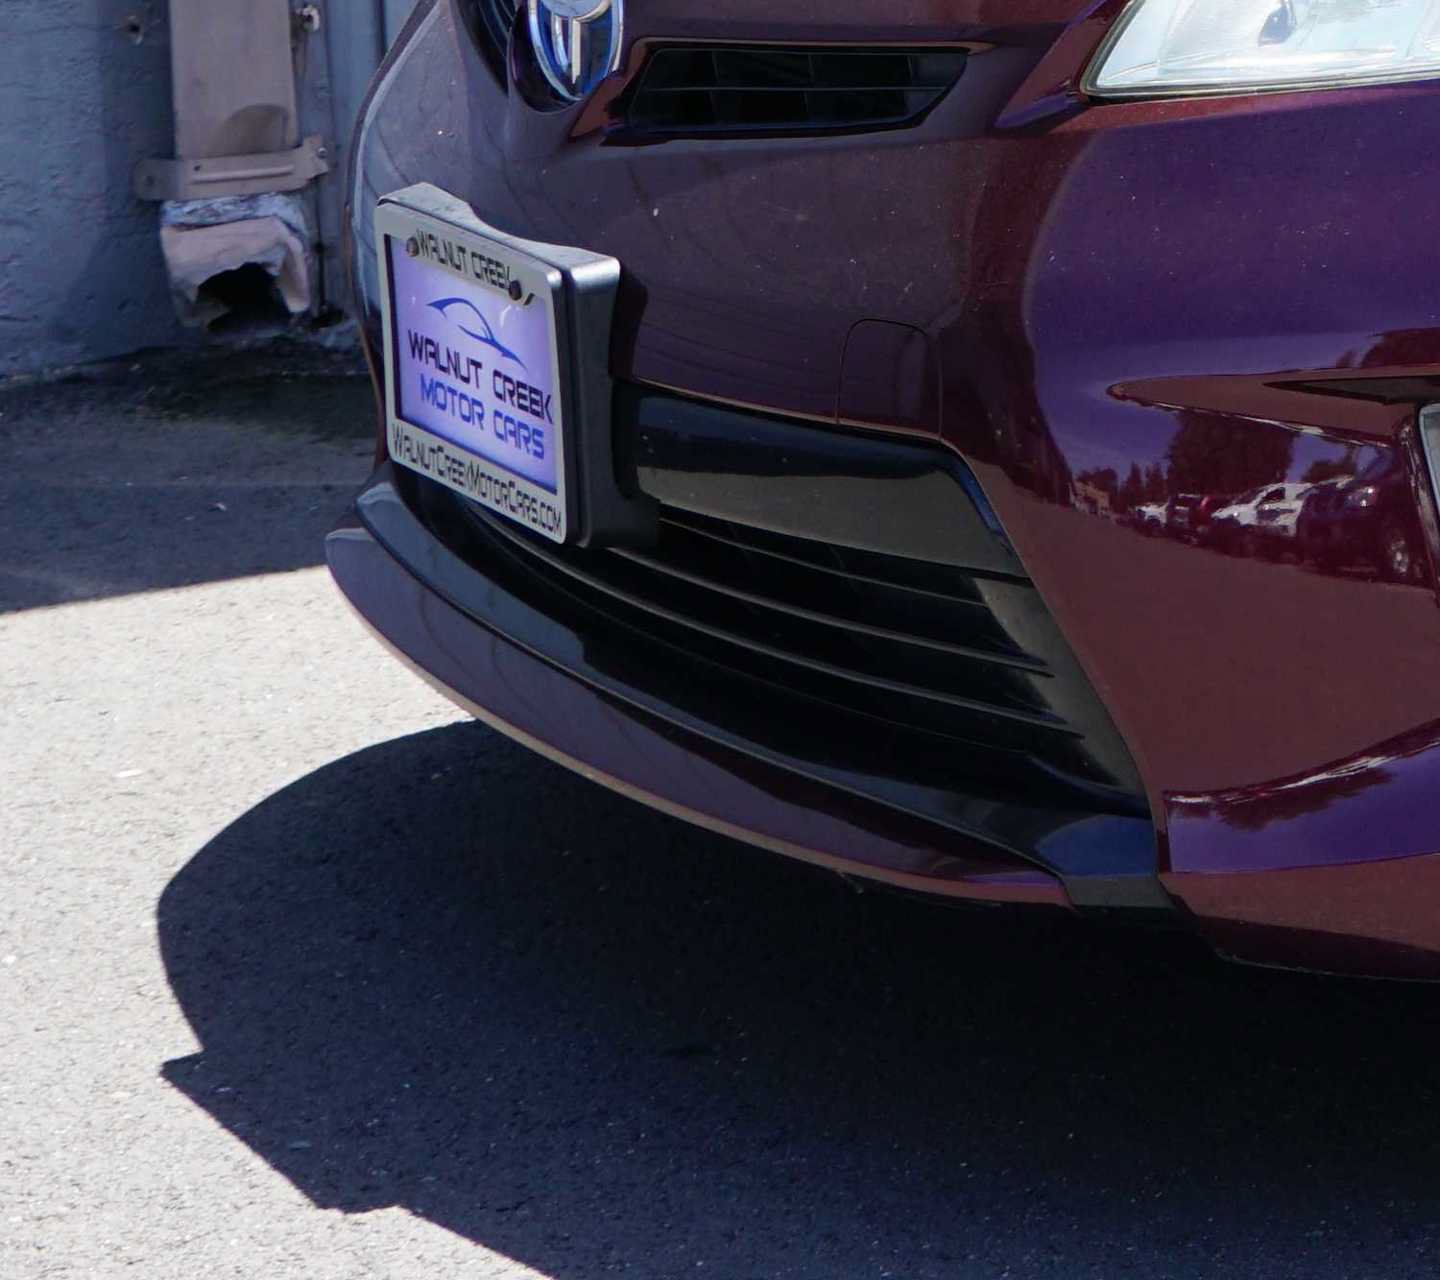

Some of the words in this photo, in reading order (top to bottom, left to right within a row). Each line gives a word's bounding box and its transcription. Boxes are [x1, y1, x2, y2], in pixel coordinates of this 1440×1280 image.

[417, 228, 467, 271] WALNUT
[470, 247, 513, 290] CREEK
[408, 329, 483, 389] WALNUT
[492, 370, 554, 424] CREEK
[420, 373, 485, 430] MOTOR
[493, 410, 546, 460] CARS
